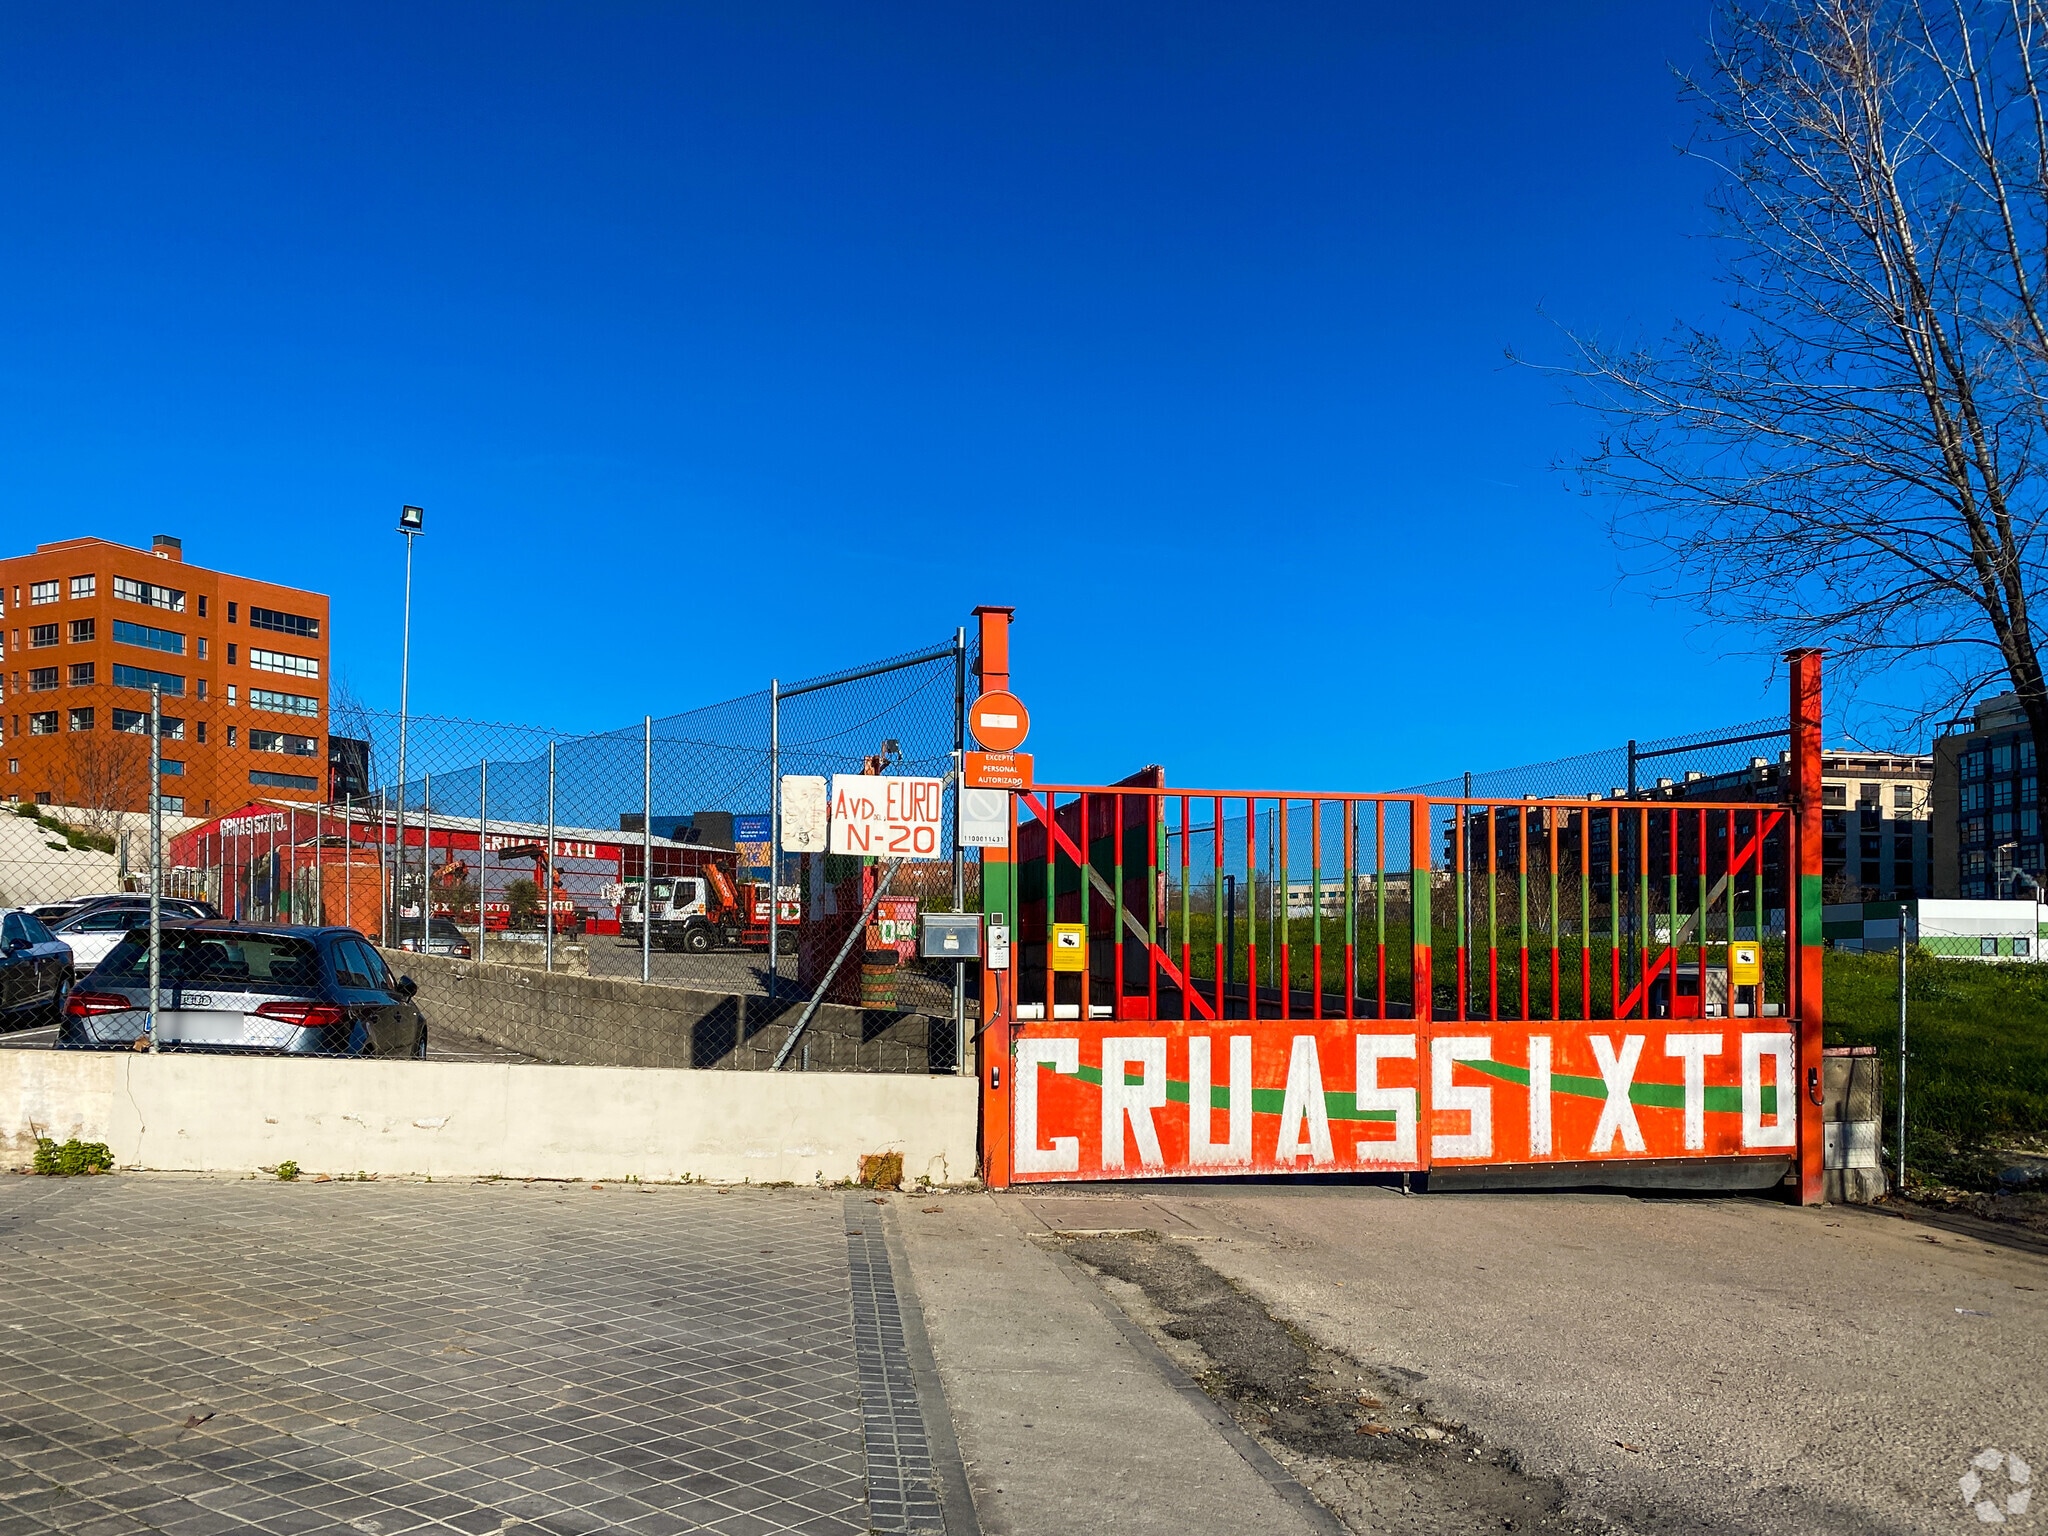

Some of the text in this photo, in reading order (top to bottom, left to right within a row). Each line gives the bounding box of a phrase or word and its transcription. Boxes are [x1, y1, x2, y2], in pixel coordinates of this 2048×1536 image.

[978, 776, 1023, 785] AUTORIZADO
[983, 765, 1018, 773] PERSONAL
[886, 781, 940, 822] EURO
[847, 823, 935, 853] N-20
[1431, 1031, 1797, 1158] SIXTO
